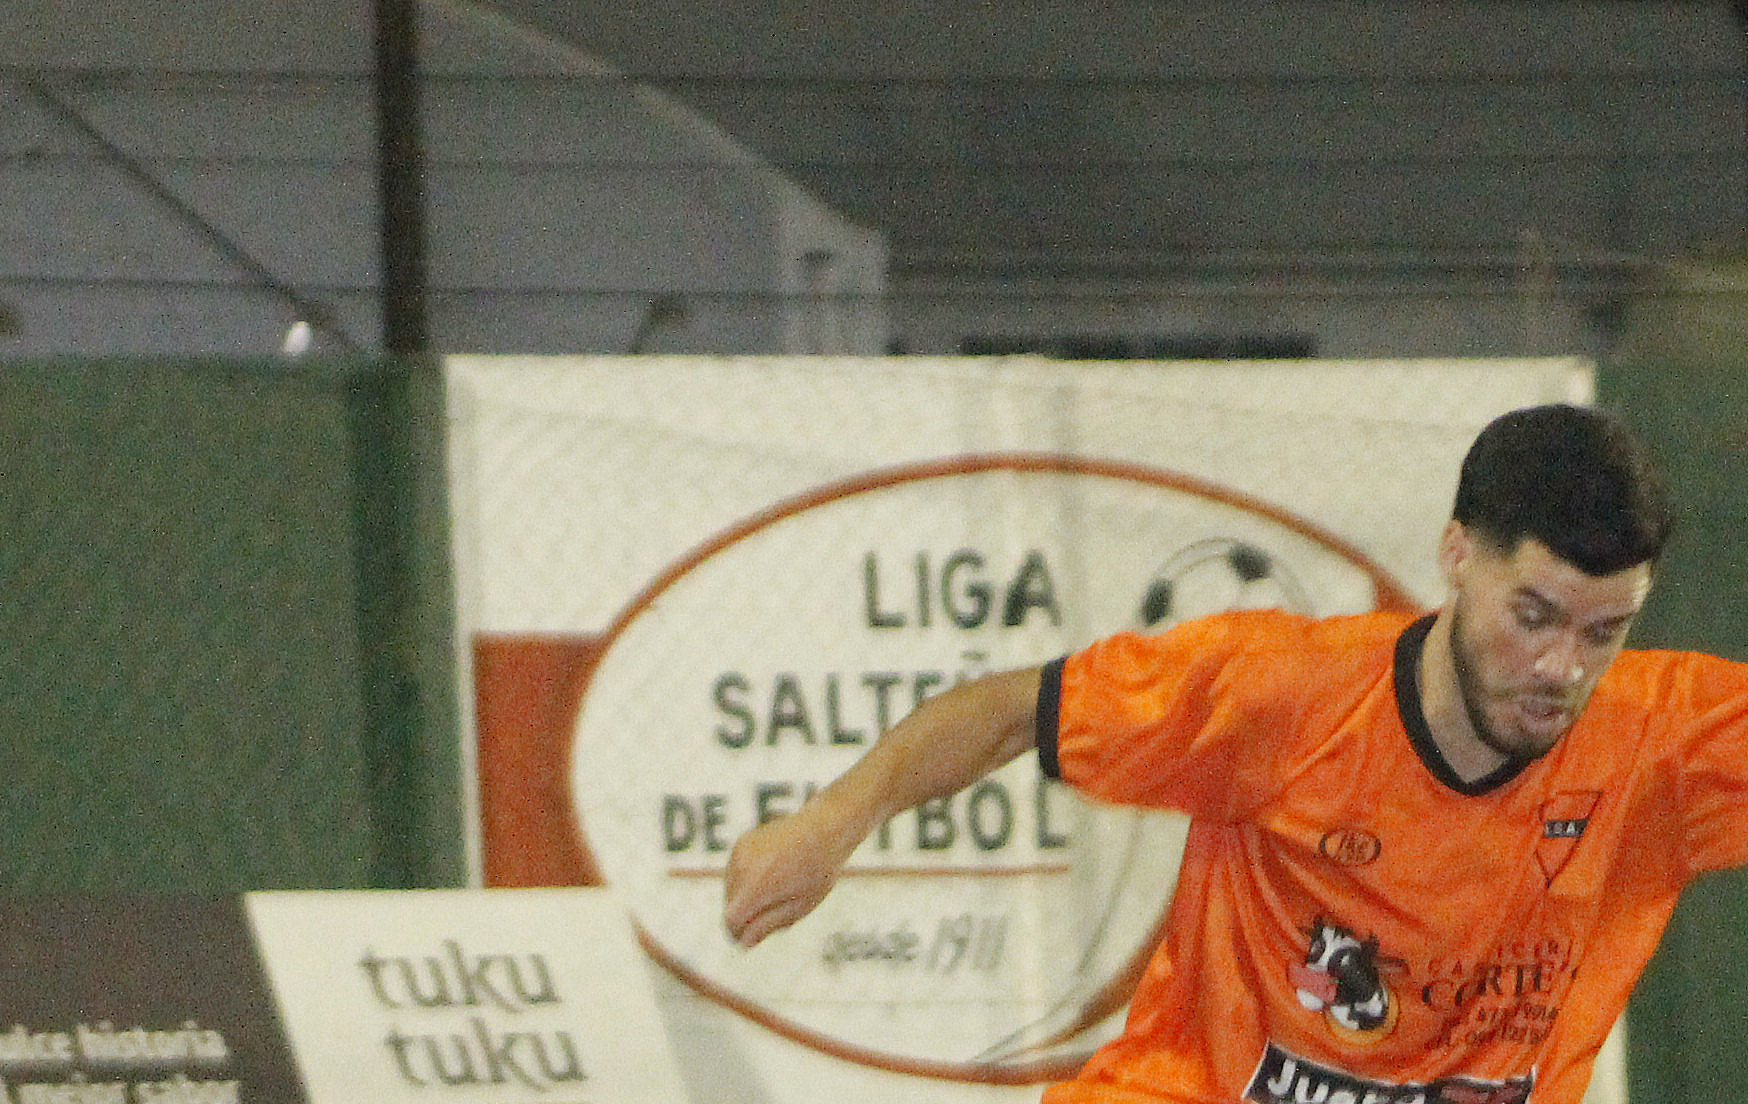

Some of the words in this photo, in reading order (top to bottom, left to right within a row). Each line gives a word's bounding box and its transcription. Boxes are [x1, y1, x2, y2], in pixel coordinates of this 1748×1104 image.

[864, 548, 1064, 630] LIGA
[663, 796, 730, 853] DE
[357, 939, 562, 1013] tuku
[383, 1018, 588, 1093] tuku
